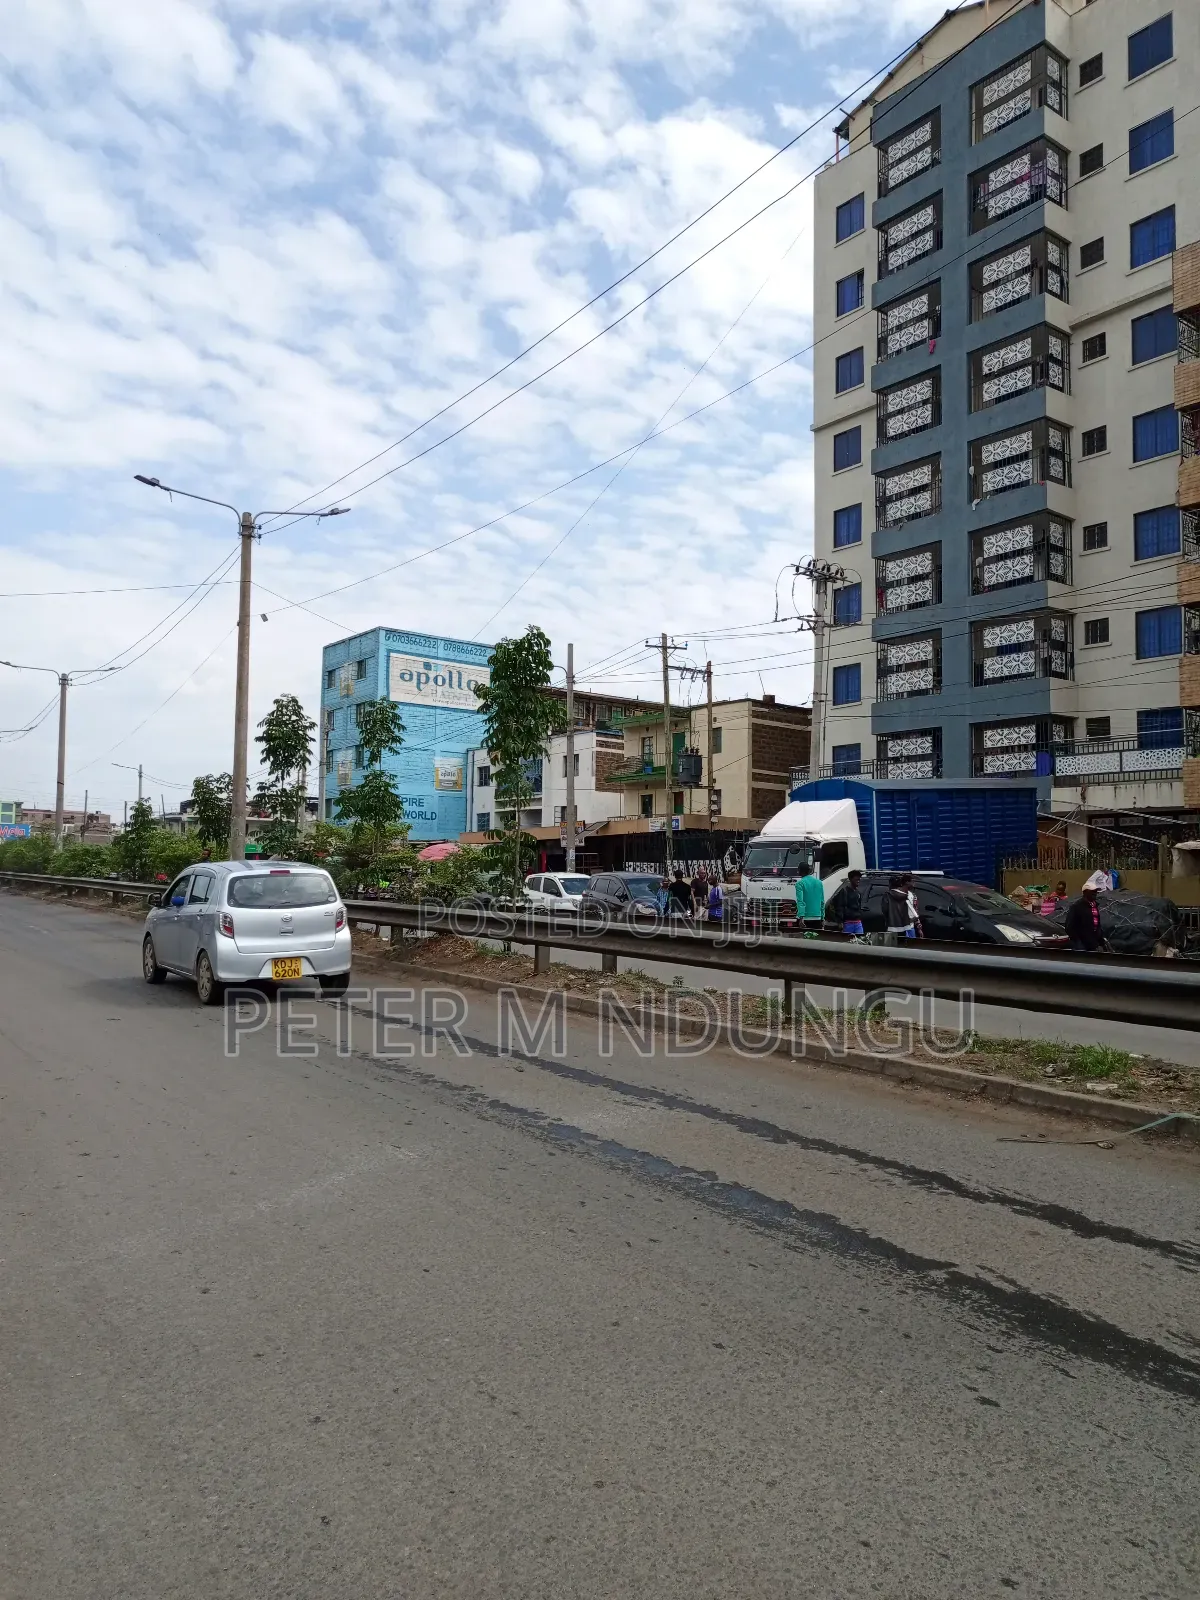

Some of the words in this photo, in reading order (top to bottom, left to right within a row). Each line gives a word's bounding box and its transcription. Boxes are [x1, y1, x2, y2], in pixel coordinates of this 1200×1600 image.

[403, 810, 437, 821] WORLD
[273, 959, 293, 969] KDJ
[274, 968, 300, 978] 620N
